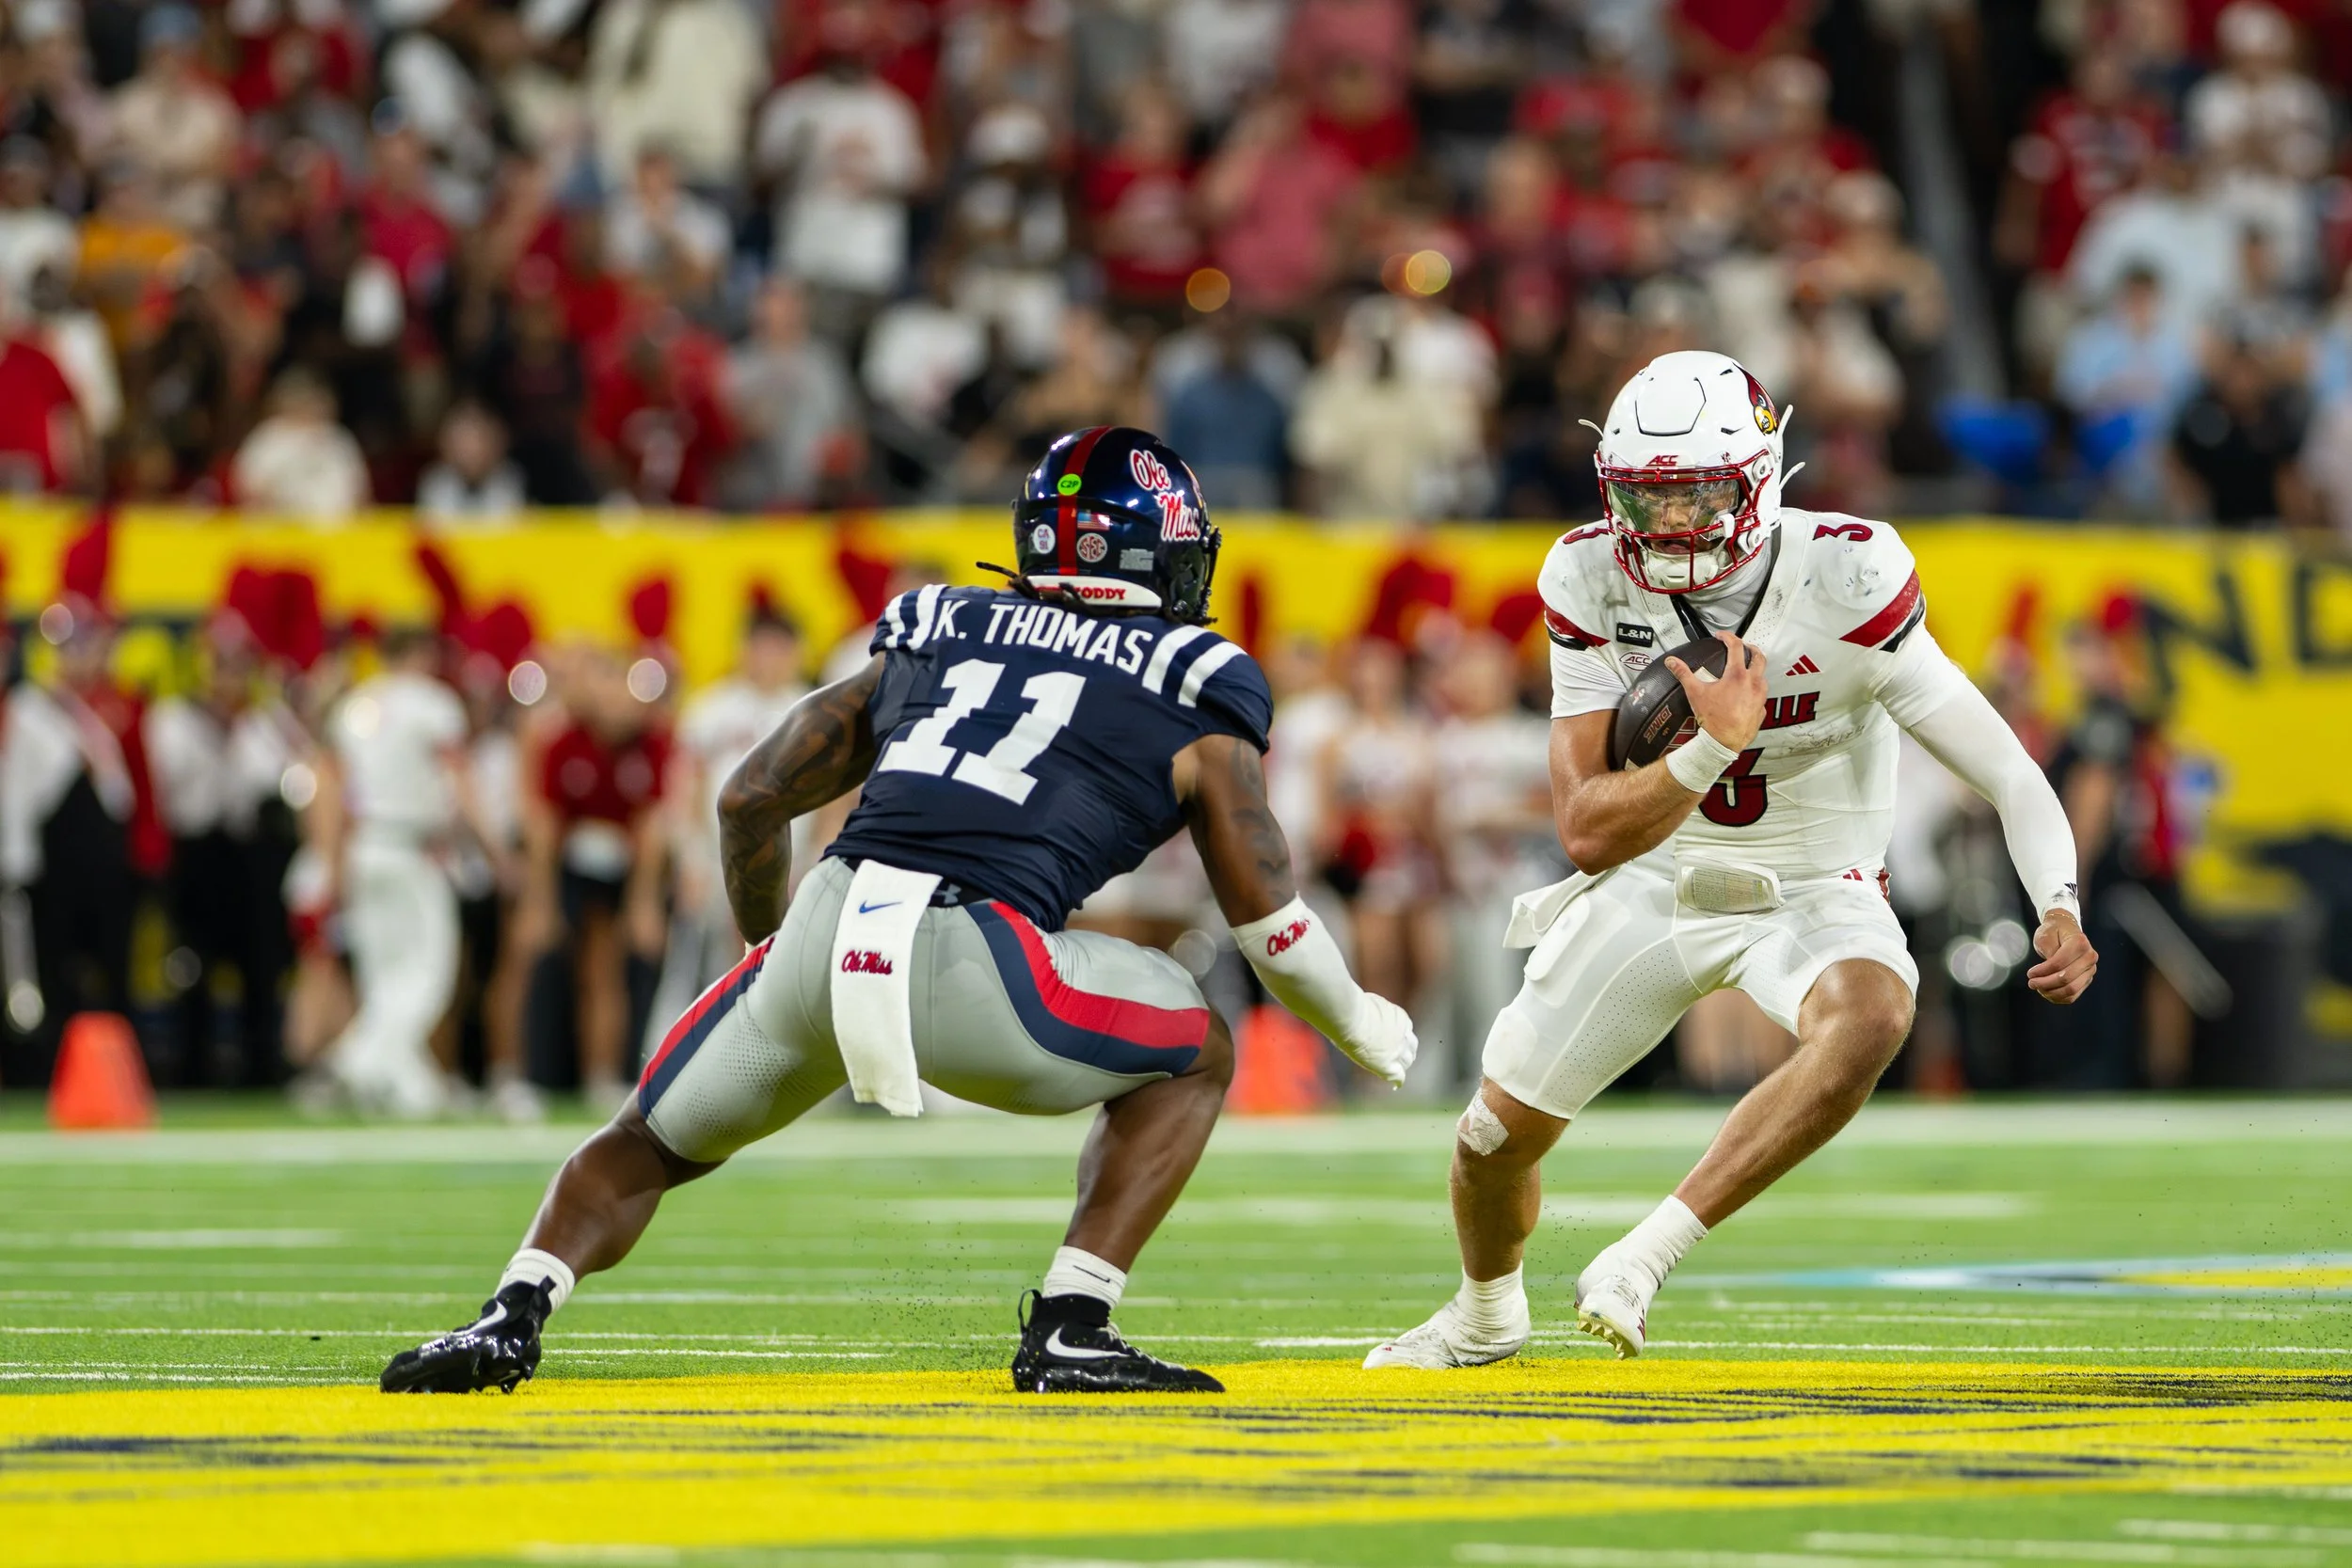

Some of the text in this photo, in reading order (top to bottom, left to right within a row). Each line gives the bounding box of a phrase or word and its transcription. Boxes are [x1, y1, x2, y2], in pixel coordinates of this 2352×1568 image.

[1131, 450, 1172, 490] Ole
[1645, 455, 1678, 467] ACC
[1813, 523, 1873, 543] 3
[1076, 587, 1126, 600] ODDY
[932, 599, 1153, 674] K. THOMAS
[1618, 627, 1653, 641] L&N
[878, 658, 1087, 806] 11
